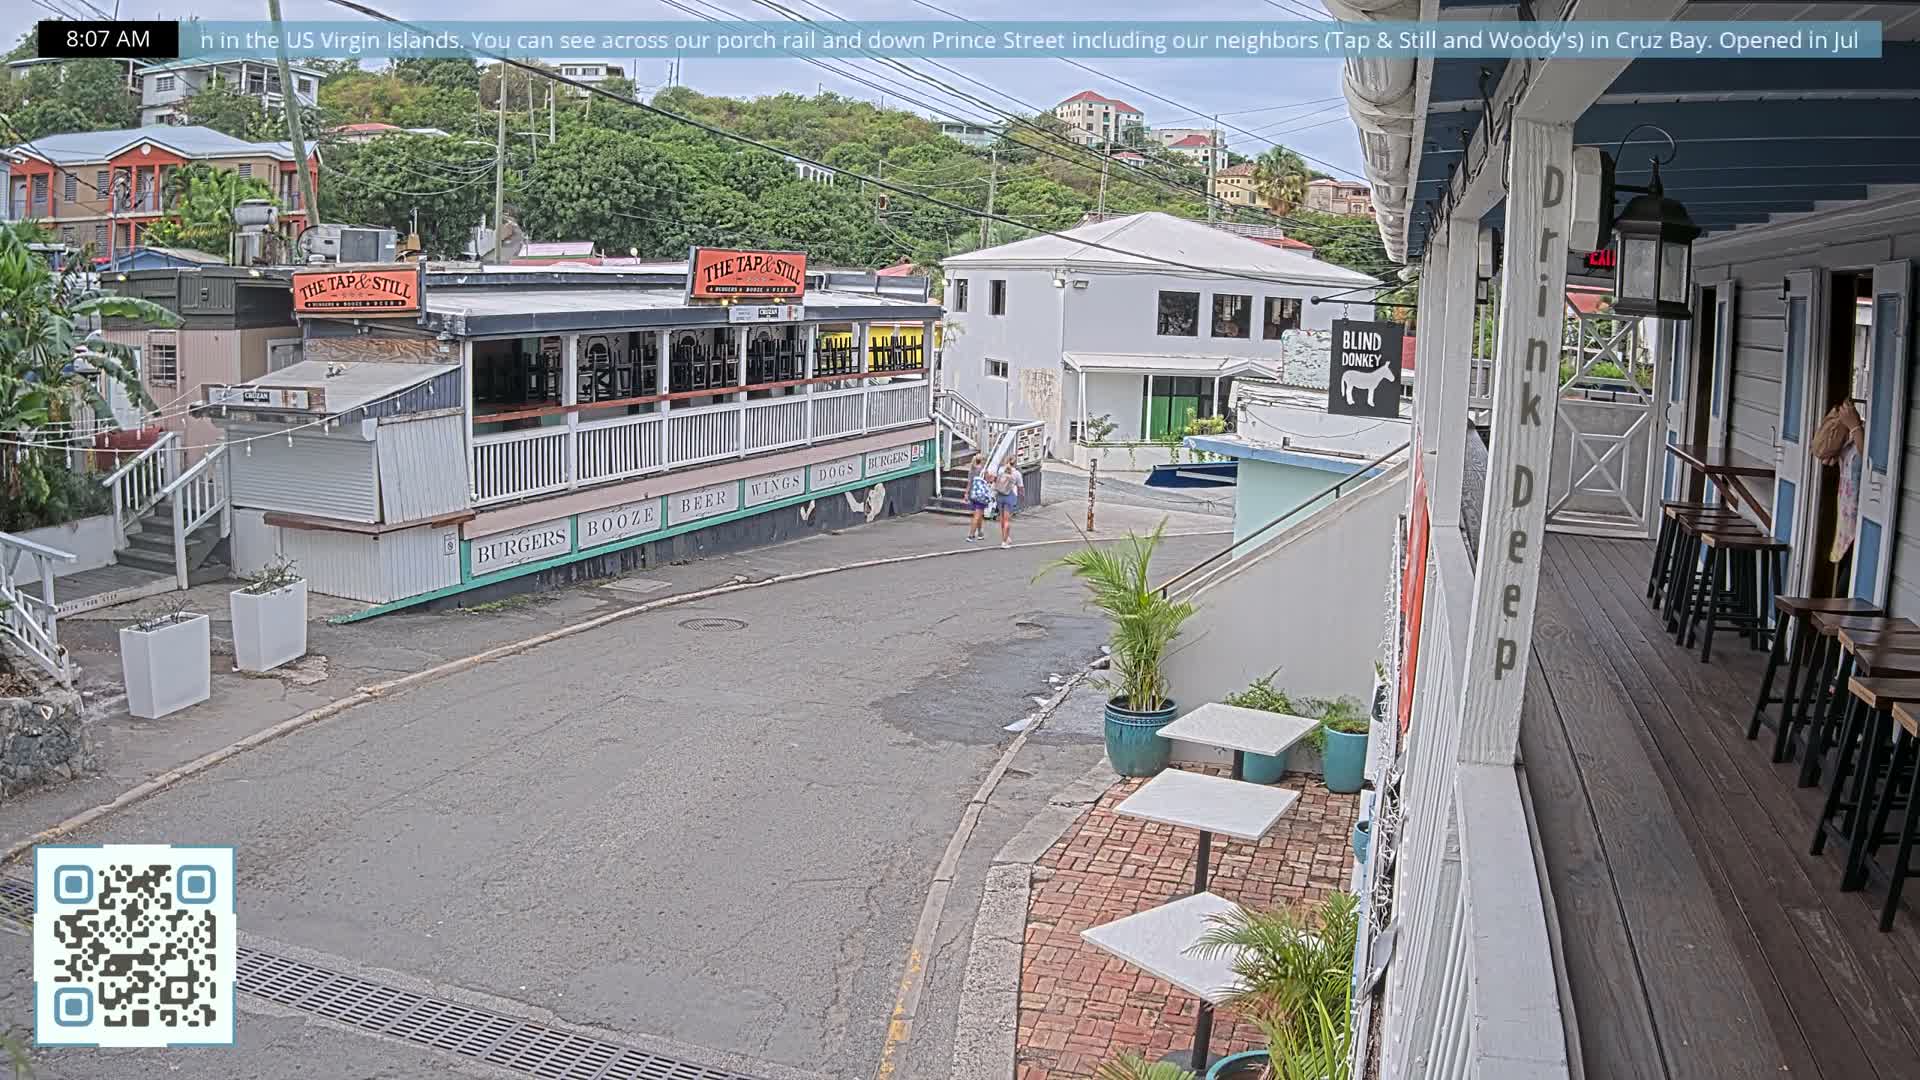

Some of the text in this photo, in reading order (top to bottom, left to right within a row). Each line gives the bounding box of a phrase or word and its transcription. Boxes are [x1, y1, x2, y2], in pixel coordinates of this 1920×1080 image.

[703, 259, 734, 283] THE
[736, 255, 762, 272] TAP
[775, 259, 801, 285] STILL
[300, 280, 327, 300] THE
[327, 275, 356, 291] TAP
[372, 276, 411, 299] STILL
[1342, 331, 1382, 351] BLIND
[1342, 352, 1382, 367] DONKEY
[244, 391, 268, 399] CRUZAN
[1494, 165, 1565, 680] Drink Deep
[868, 449, 909, 470] BURGERS
[819, 463, 854, 481] DOGS
[751, 475, 800, 497] WINGS
[682, 490, 726, 513] BEER
[588, 507, 654, 537] BOOZE
[478, 528, 566, 563] BURGERS
